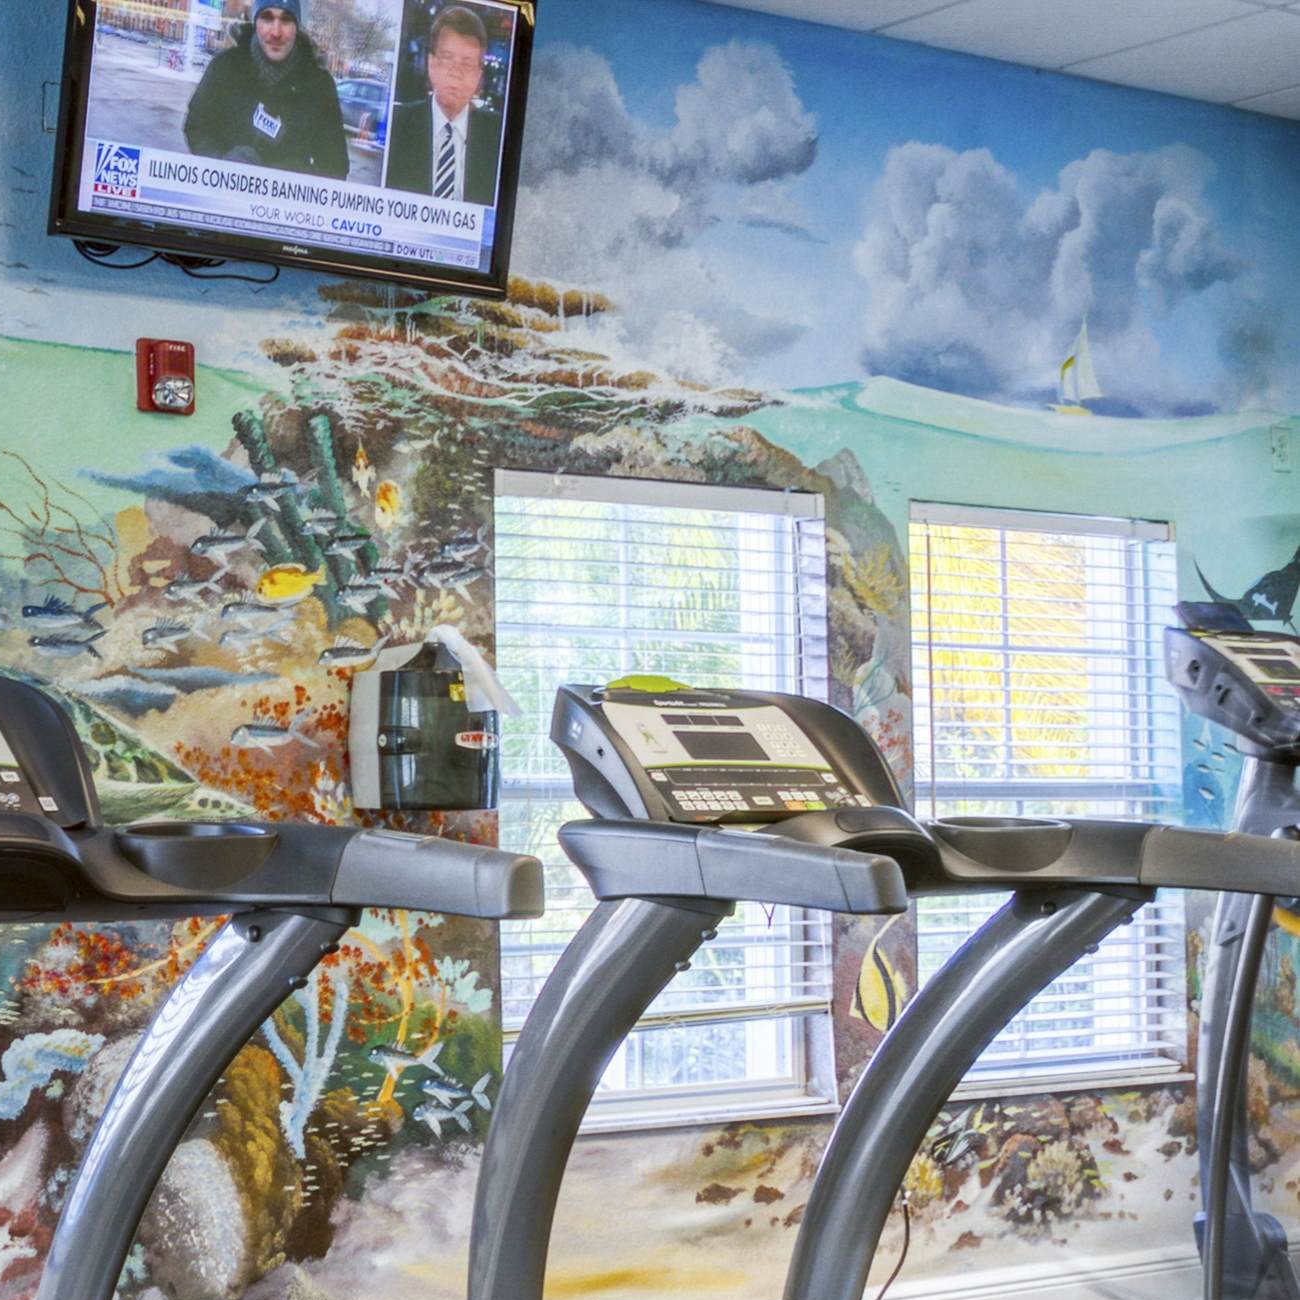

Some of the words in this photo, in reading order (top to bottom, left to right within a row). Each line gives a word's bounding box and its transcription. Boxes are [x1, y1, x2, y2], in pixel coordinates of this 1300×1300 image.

[109, 155, 138, 173] FOX
[101, 169, 138, 187] NEWS
[149, 160, 198, 184] ILLINOIS
[201, 168, 269, 196] CONSIDERS
[271, 180, 328, 207] BANNING
[330, 189, 384, 216] PUMPING
[387, 200, 423, 224] YOUR
[420, 206, 452, 226] OWN
[452, 211, 476, 231] GAS
[250, 204, 280, 220] YOUR
[284, 210, 325, 227] WORLD
[330, 217, 383, 237] CAVUTO
[396, 244, 417, 257] DOW
